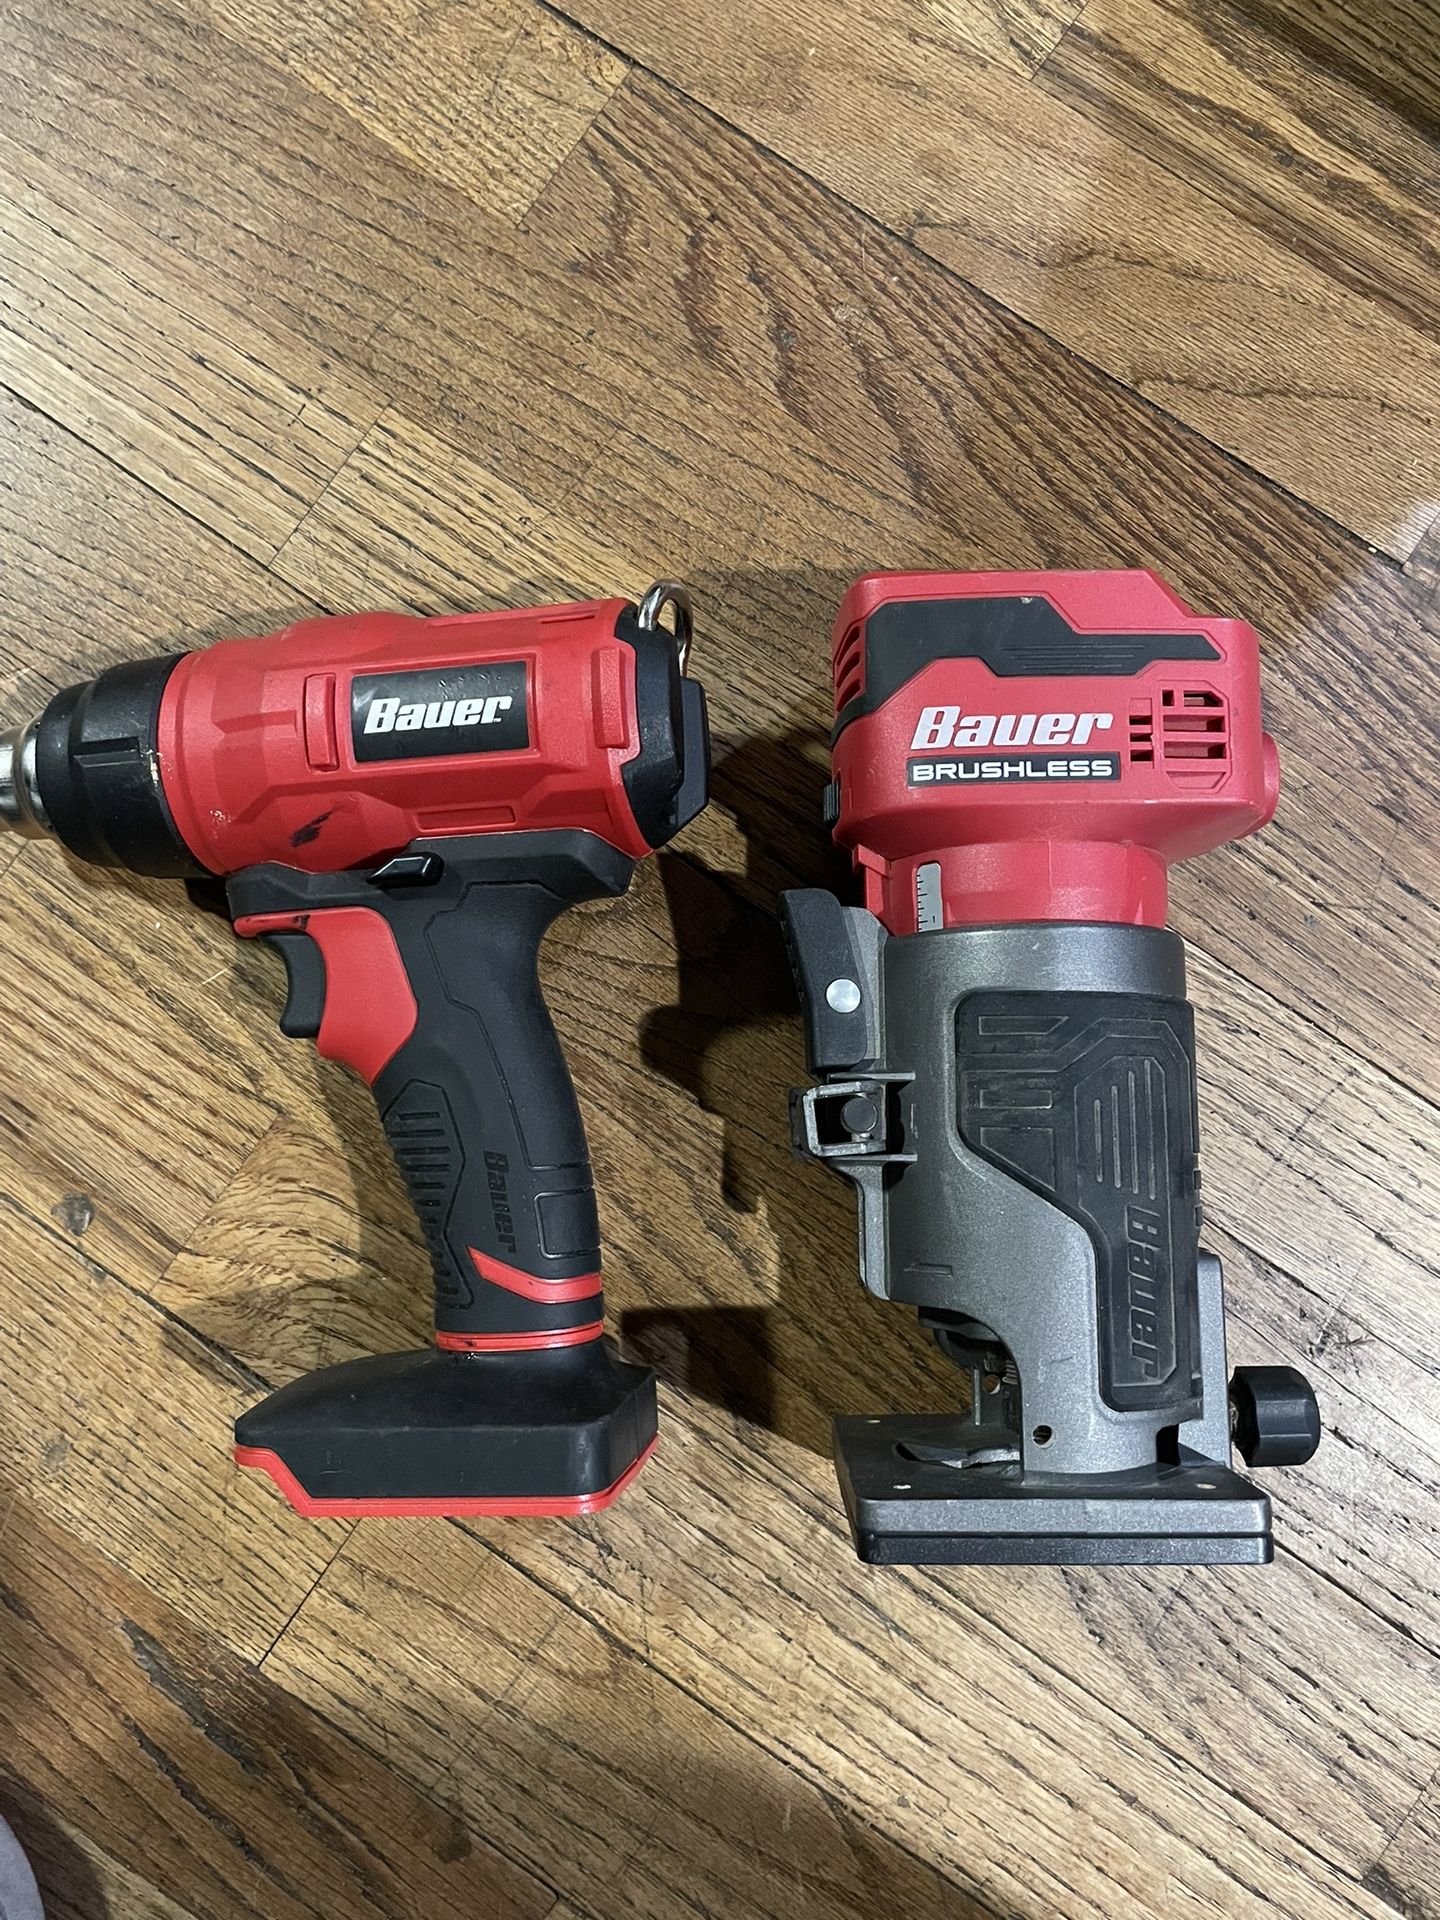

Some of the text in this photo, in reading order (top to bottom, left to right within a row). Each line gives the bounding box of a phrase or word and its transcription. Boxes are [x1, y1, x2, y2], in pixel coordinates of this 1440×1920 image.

[363, 695, 513, 734] Bauer
[910, 705, 1114, 750] Bauer
[912, 760, 1112, 782] BRUSHLESS
[483, 1150, 517, 1254] Bauer
[1125, 1204, 1162, 1379] Bauer
